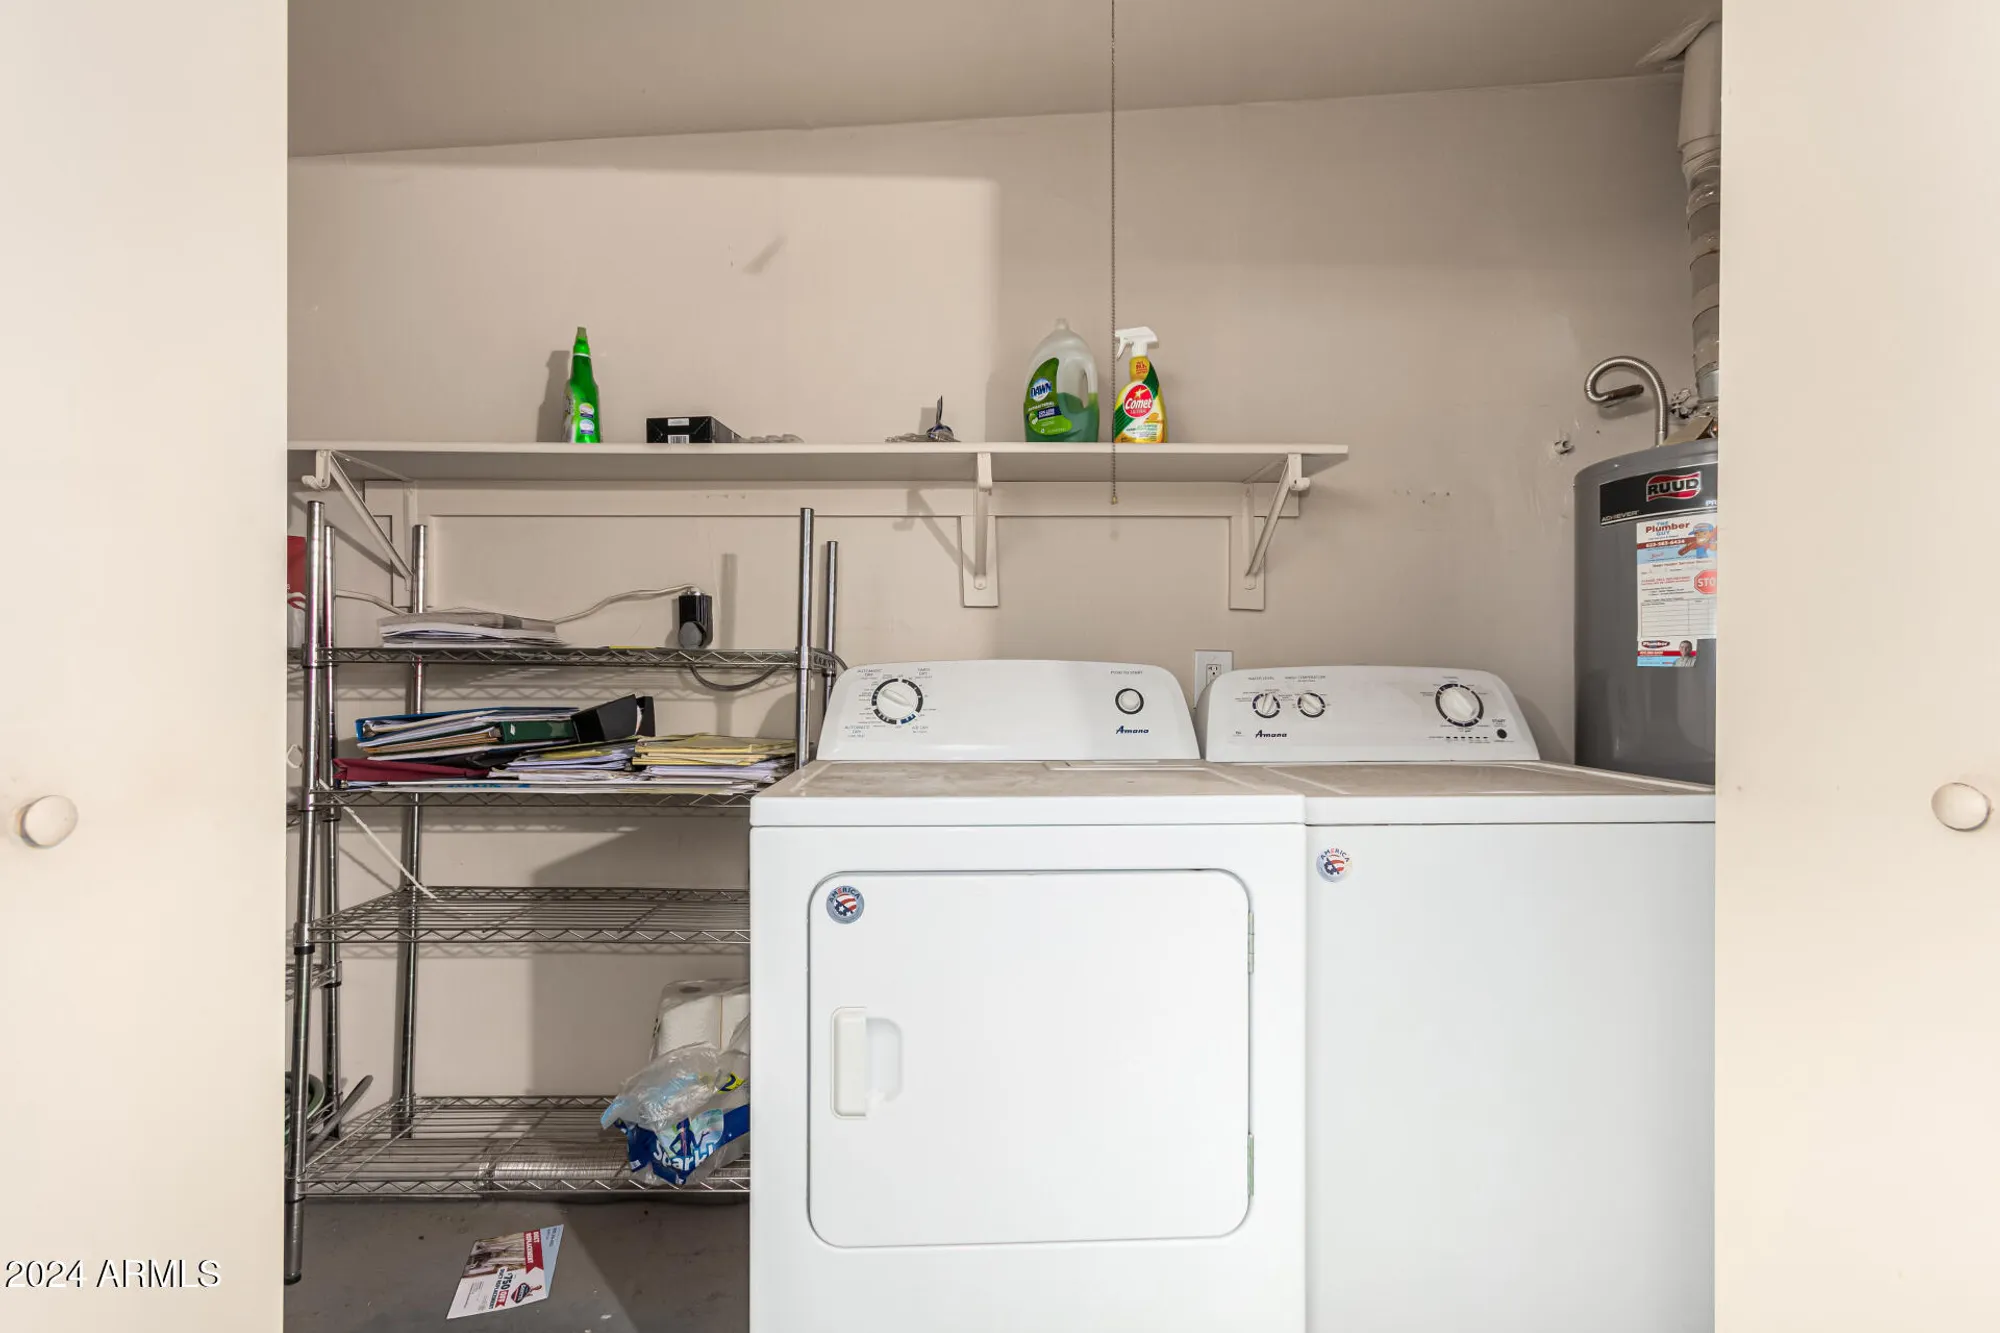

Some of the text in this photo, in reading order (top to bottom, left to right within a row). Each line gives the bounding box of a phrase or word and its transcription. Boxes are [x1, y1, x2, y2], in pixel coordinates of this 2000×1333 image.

[1030, 382, 1052, 398] DAWN
[1125, 398, 1152, 410] Comet
[1647, 478, 1700, 496] RUUD
[1601, 509, 1638, 522] ACHIEVER
[1645, 522, 1691, 533] Plumber
[1697, 577, 1717, 587] STO
[1116, 725, 1150, 734] Amana
[1254, 730, 1288, 738] Amana
[1320, 848, 1350, 862] AMERICA
[828, 886, 861, 903] AMERICA
